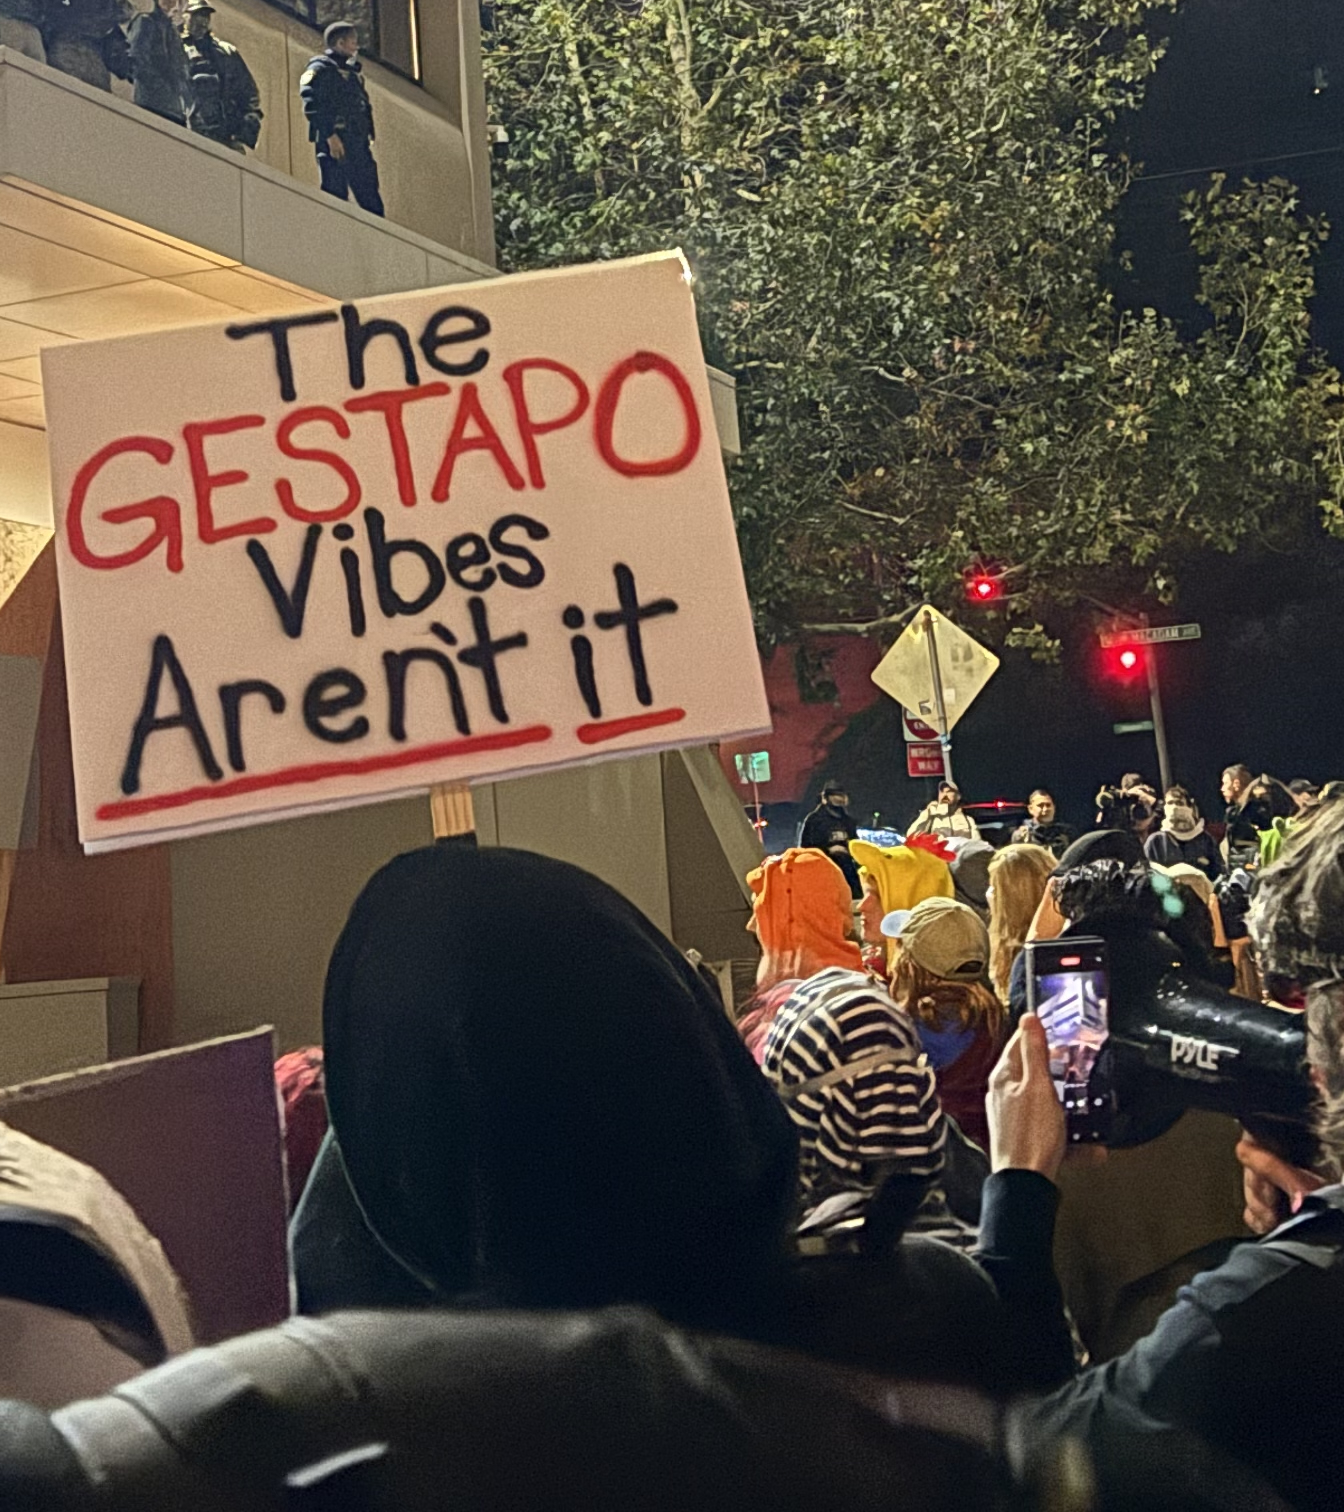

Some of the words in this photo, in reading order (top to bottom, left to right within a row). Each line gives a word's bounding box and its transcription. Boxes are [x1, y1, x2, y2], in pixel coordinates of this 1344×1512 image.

[226, 303, 492, 402] The
[66, 350, 701, 573] GESTAPO
[246, 507, 549, 639] Vibes
[121, 596, 528, 796] Aren't
[562, 562, 680, 719] it
[911, 747, 941, 758] WRO
[917, 760, 940, 770] WAY
[1171, 1035, 1219, 1070] PYLE
